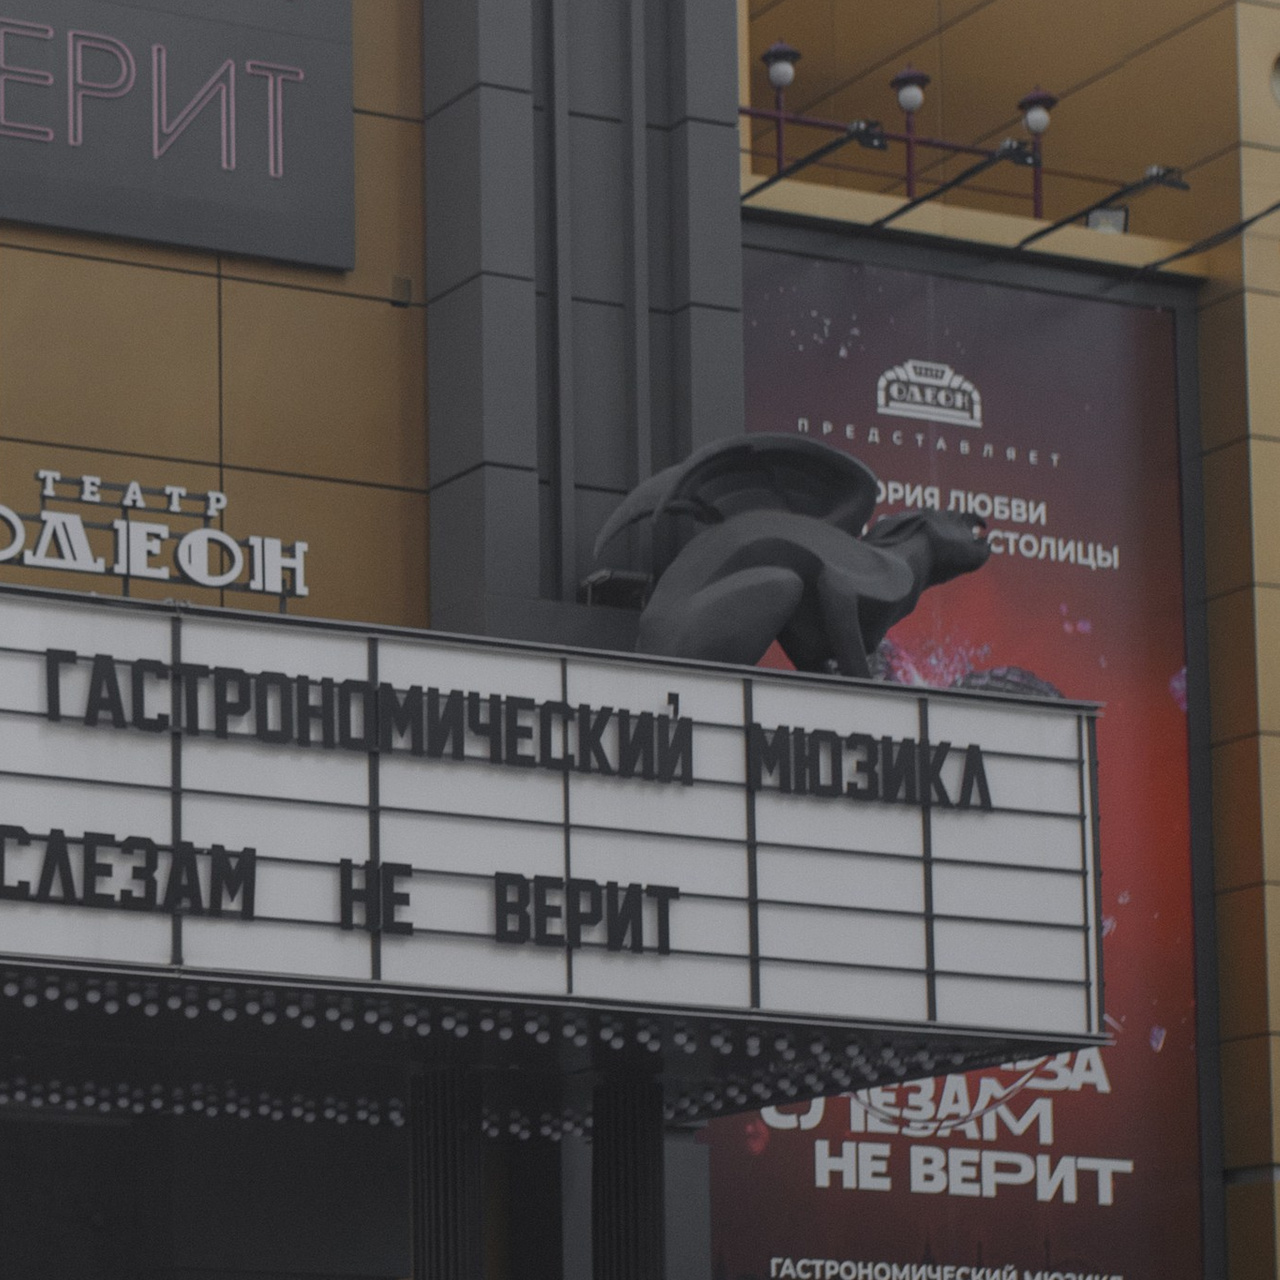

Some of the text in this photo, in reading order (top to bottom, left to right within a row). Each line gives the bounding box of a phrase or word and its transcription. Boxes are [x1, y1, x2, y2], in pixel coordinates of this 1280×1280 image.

[797, 418, 1062, 468] ПРЕДСТАВЛЯЕТ
[38, 469, 228, 517] ТЕАТР
[947, 489, 1047, 525] ЛЮБВИ
[987, 529, 1120, 570] СТОЛИЦЫ
[44, 648, 694, 787] ГАСТРОНОМИЧЕСКИЙ
[749, 722, 992, 813] МЮЗИКЛ
[339, 858, 414, 936] НЕ
[494, 872, 680, 955] ВЕРИТ
[815, 1139, 1135, 1206] НЕ ВЕРИТ
